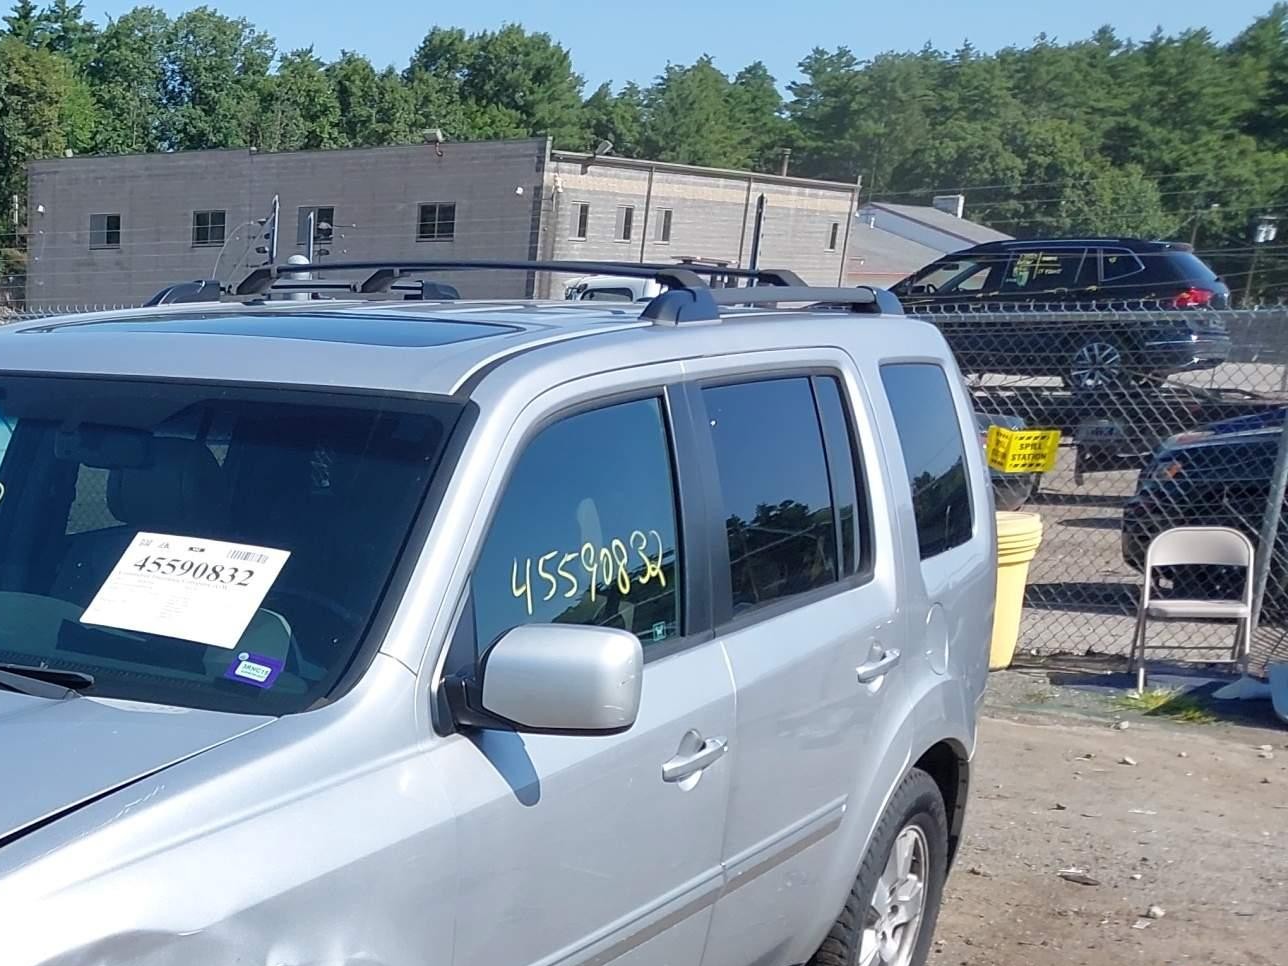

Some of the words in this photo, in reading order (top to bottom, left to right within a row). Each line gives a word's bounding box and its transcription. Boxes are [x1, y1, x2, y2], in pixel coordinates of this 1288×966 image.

[1011, 453, 1047, 461] STATION
[133, 555, 255, 588] 45590832
[511, 529, 667, 616] 45590832
